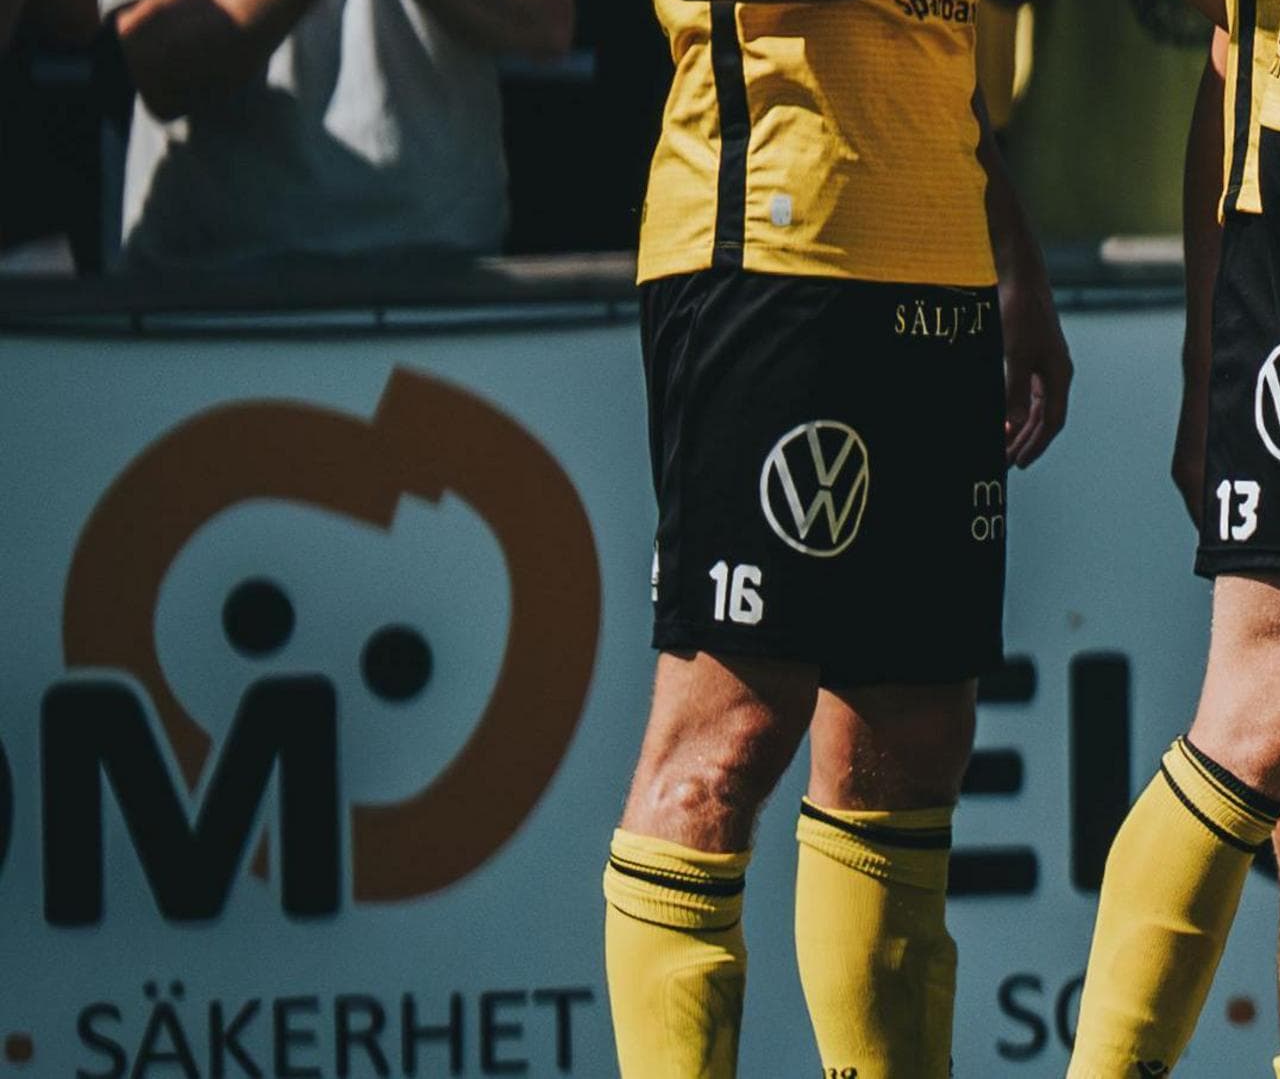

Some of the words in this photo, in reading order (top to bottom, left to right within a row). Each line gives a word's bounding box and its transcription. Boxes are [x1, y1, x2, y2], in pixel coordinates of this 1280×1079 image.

[1216, 478, 1261, 542] 13
[708, 559, 764, 625] 16
[75, 980, 595, 1079] SÄKERHET
